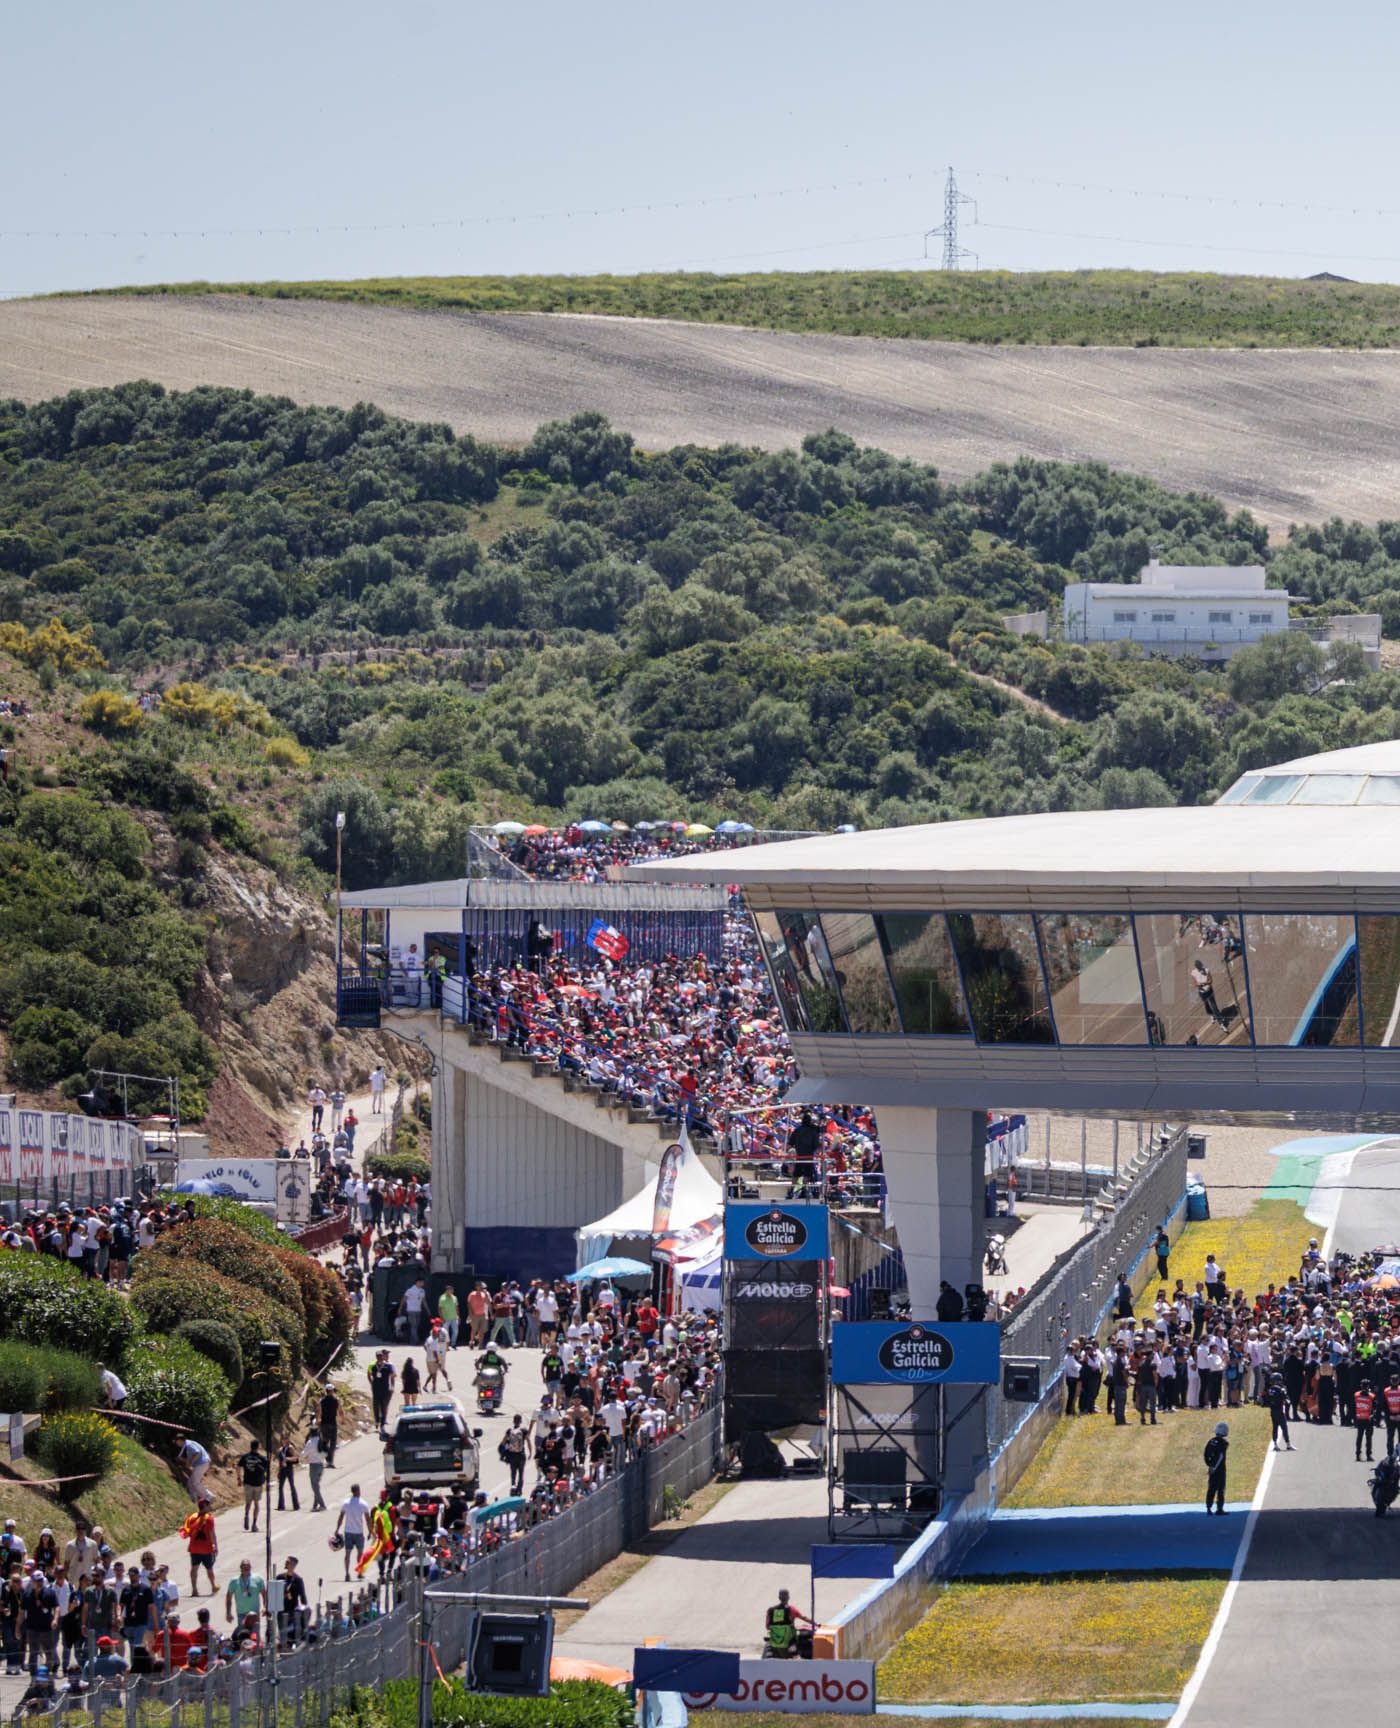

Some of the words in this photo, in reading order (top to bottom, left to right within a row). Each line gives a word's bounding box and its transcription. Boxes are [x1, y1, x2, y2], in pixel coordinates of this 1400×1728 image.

[756, 1222, 797, 1233] Estrella
[757, 1233, 795, 1244] Galicia
[891, 1340, 942, 1353] Estrella
[893, 1353, 940, 1367] Galicia
